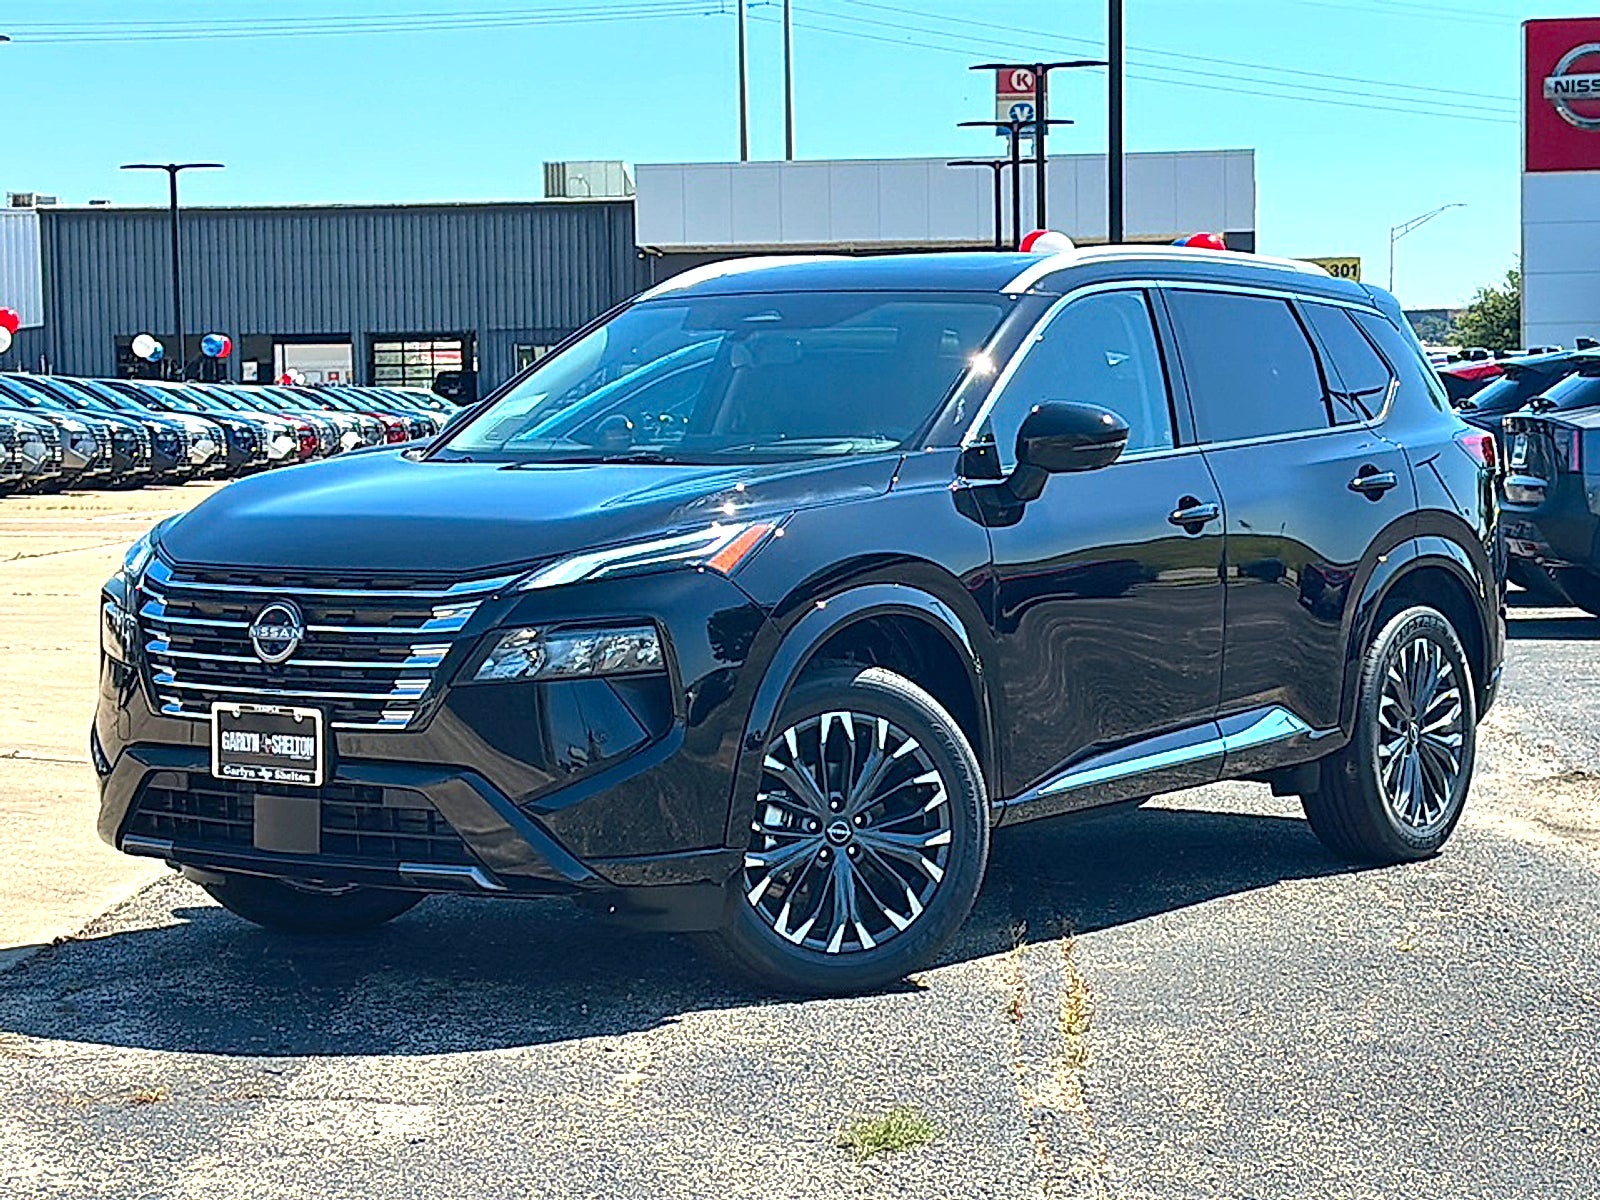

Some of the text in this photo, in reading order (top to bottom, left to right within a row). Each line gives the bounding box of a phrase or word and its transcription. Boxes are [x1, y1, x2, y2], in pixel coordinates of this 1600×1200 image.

[1016, 73, 1030, 89] K
[1554, 79, 1600, 93] NISS
[249, 626, 304, 640] NISSAN
[271, 734, 315, 757] SHELTON
[274, 770, 311, 783] Shelton
